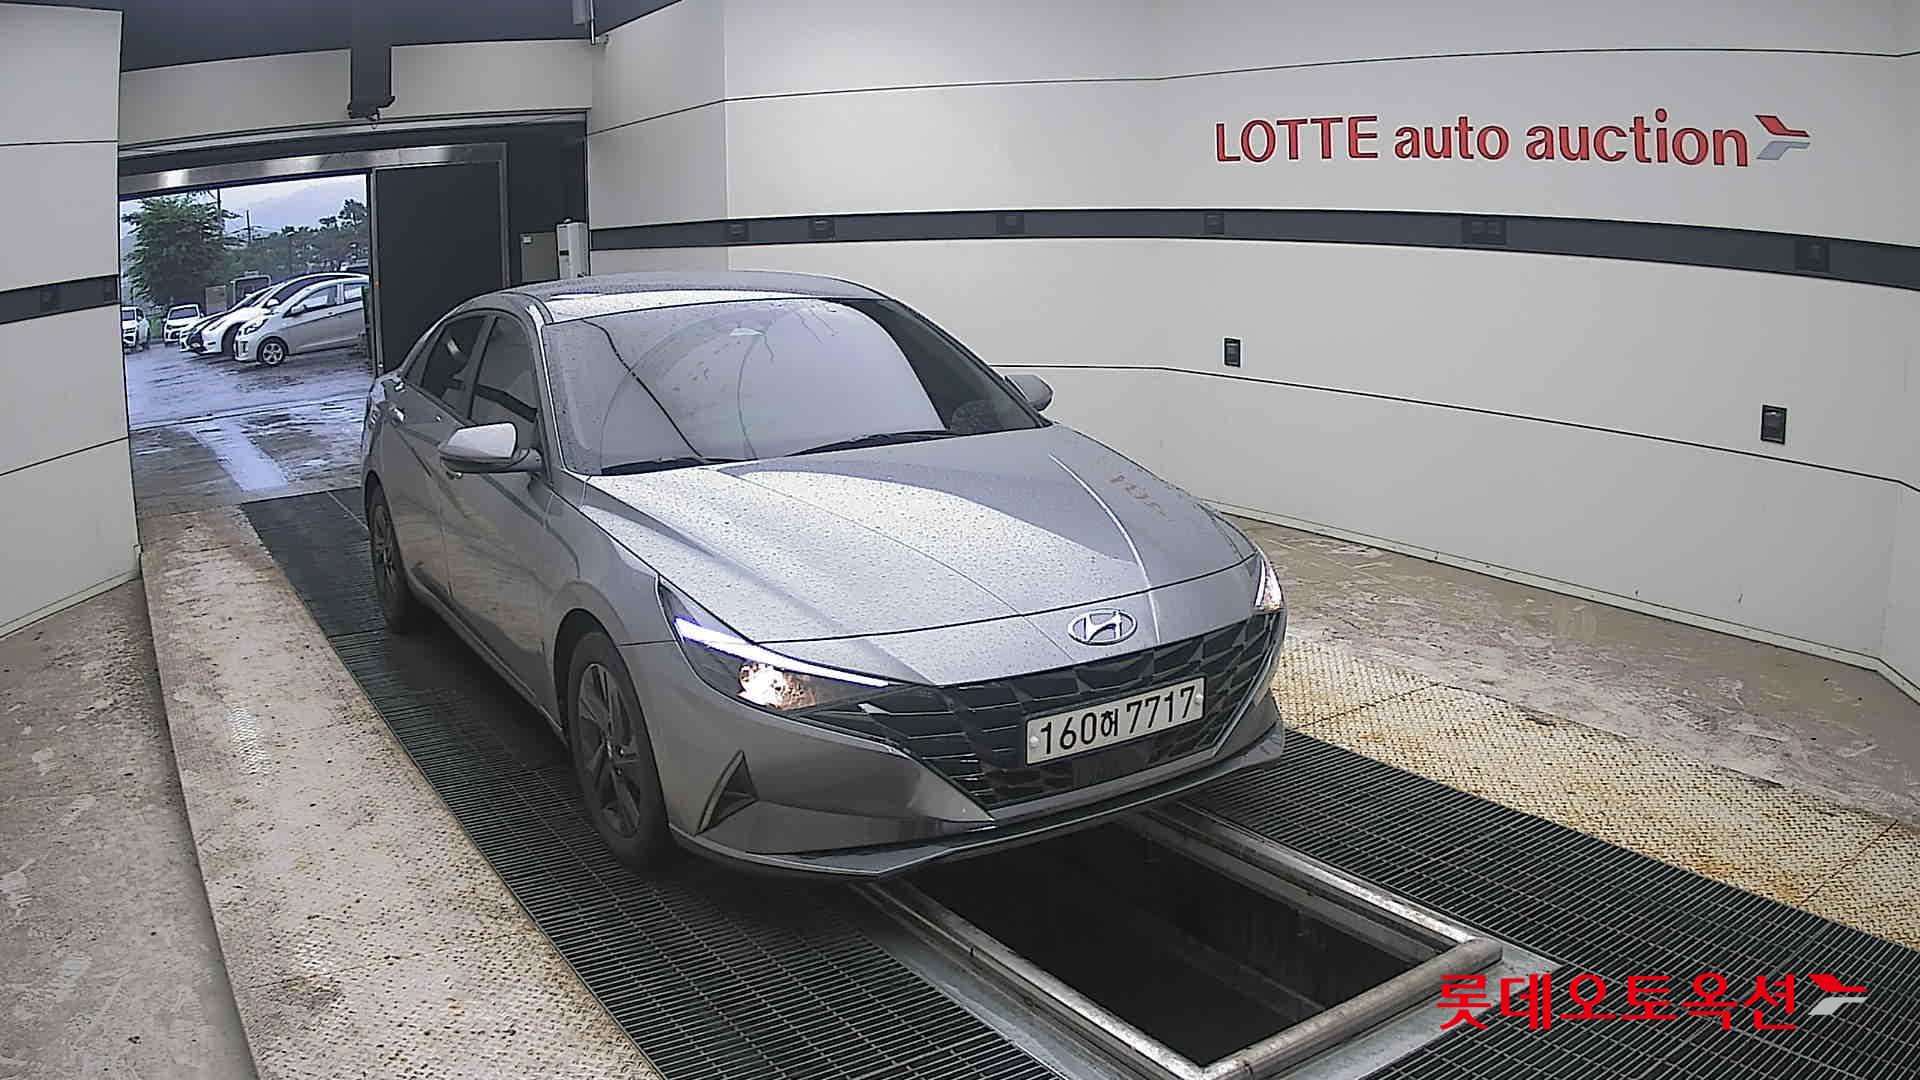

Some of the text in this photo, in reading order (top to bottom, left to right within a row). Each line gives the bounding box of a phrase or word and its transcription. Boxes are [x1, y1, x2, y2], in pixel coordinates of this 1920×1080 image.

[1215, 108, 1750, 167] LOTTE auto auction
[1040, 685, 1196, 755] 160허 7717
